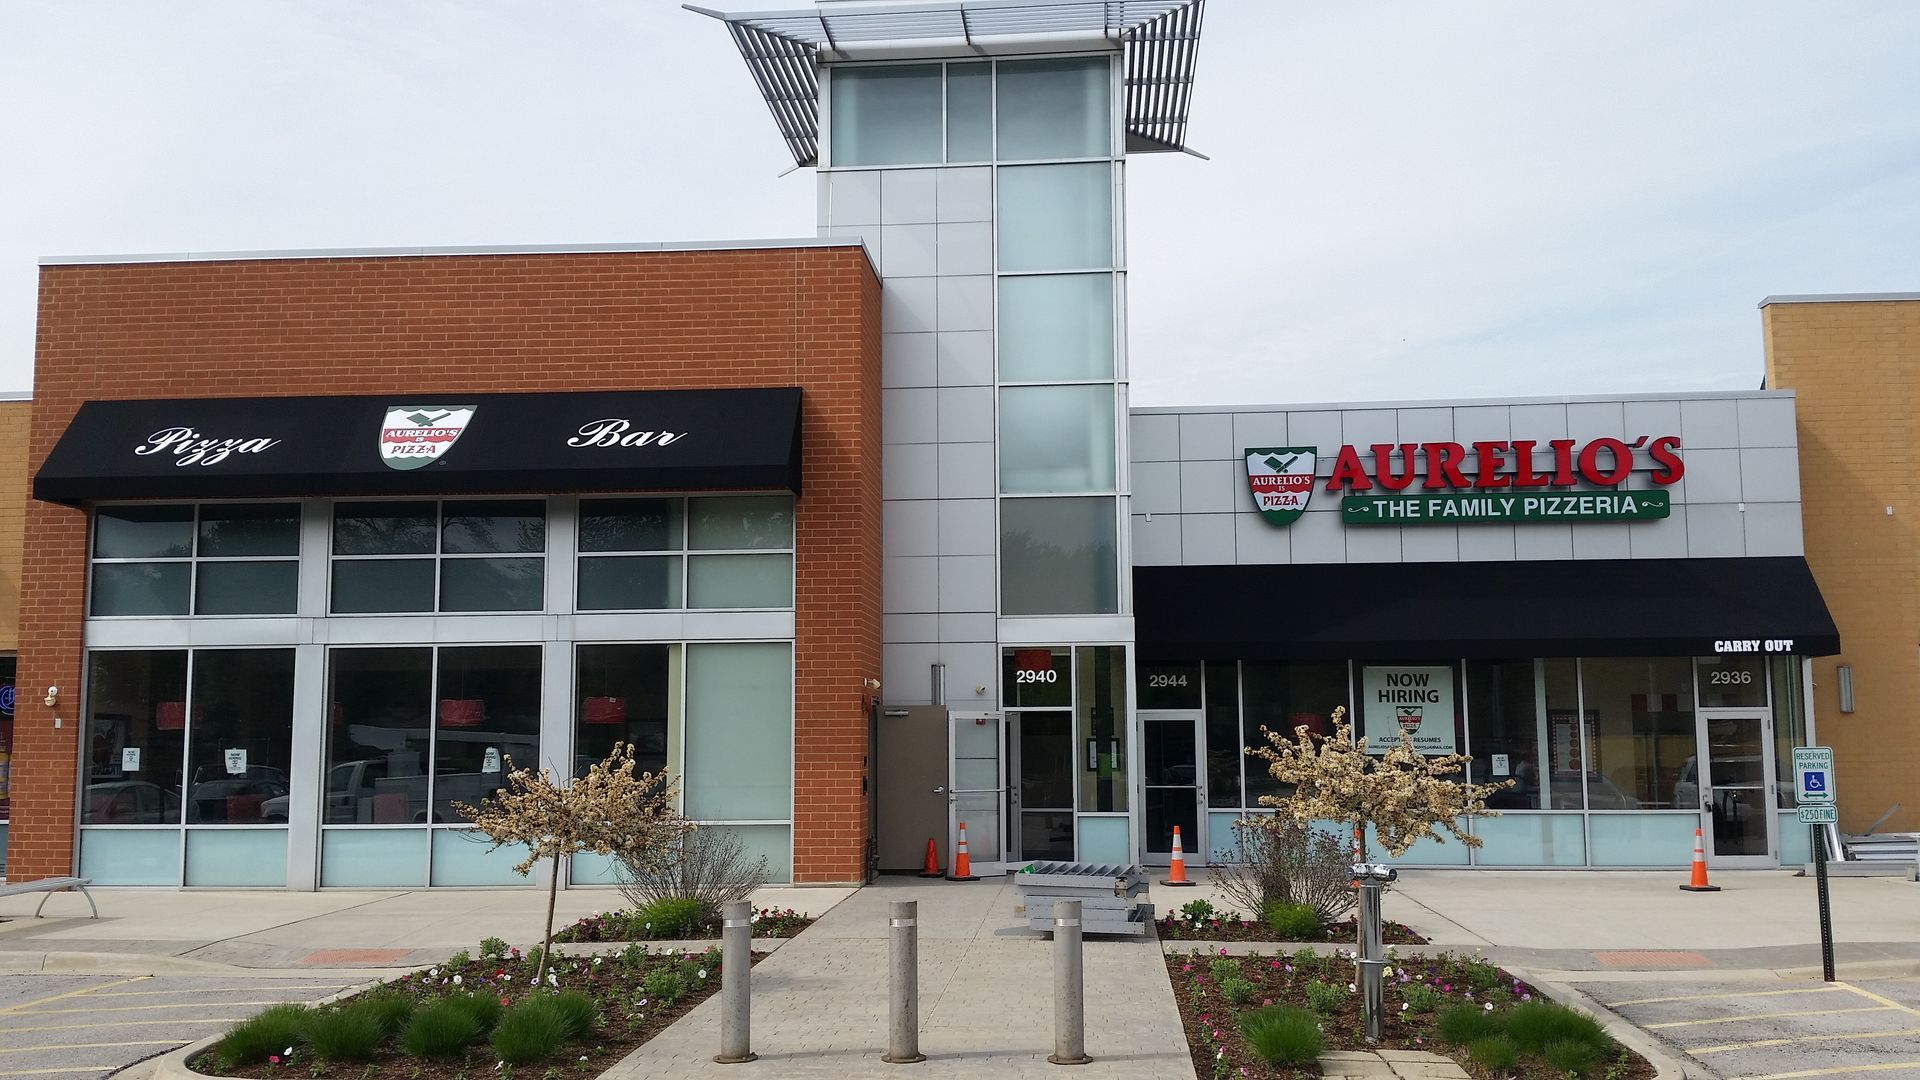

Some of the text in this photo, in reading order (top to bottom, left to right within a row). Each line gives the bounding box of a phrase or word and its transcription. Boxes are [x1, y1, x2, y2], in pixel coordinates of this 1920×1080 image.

[385, 429, 459, 438] AURELIO'S
[567, 418, 688, 447] Bar
[135, 427, 282, 467] Pizza
[391, 445, 436, 454] PIZZA
[1325, 435, 1686, 492] AURELIO'S
[1252, 475, 1311, 486] AURELIO'S
[1263, 495, 1299, 506] PIZZA
[1373, 495, 1639, 519] THE FAMILY PIZZERIA
[1714, 639, 1793, 652] CARRY OUT
[1016, 669, 1057, 684] 2940
[1149, 674, 1188, 687] 2944
[1386, 674, 1429, 687] NOW
[1711, 671, 1752, 684] 2936
[1378, 690, 1439, 703] HIRING
[1796, 752, 1830, 760] RESERVED
[1800, 808, 1835, 820] $250 FINE
